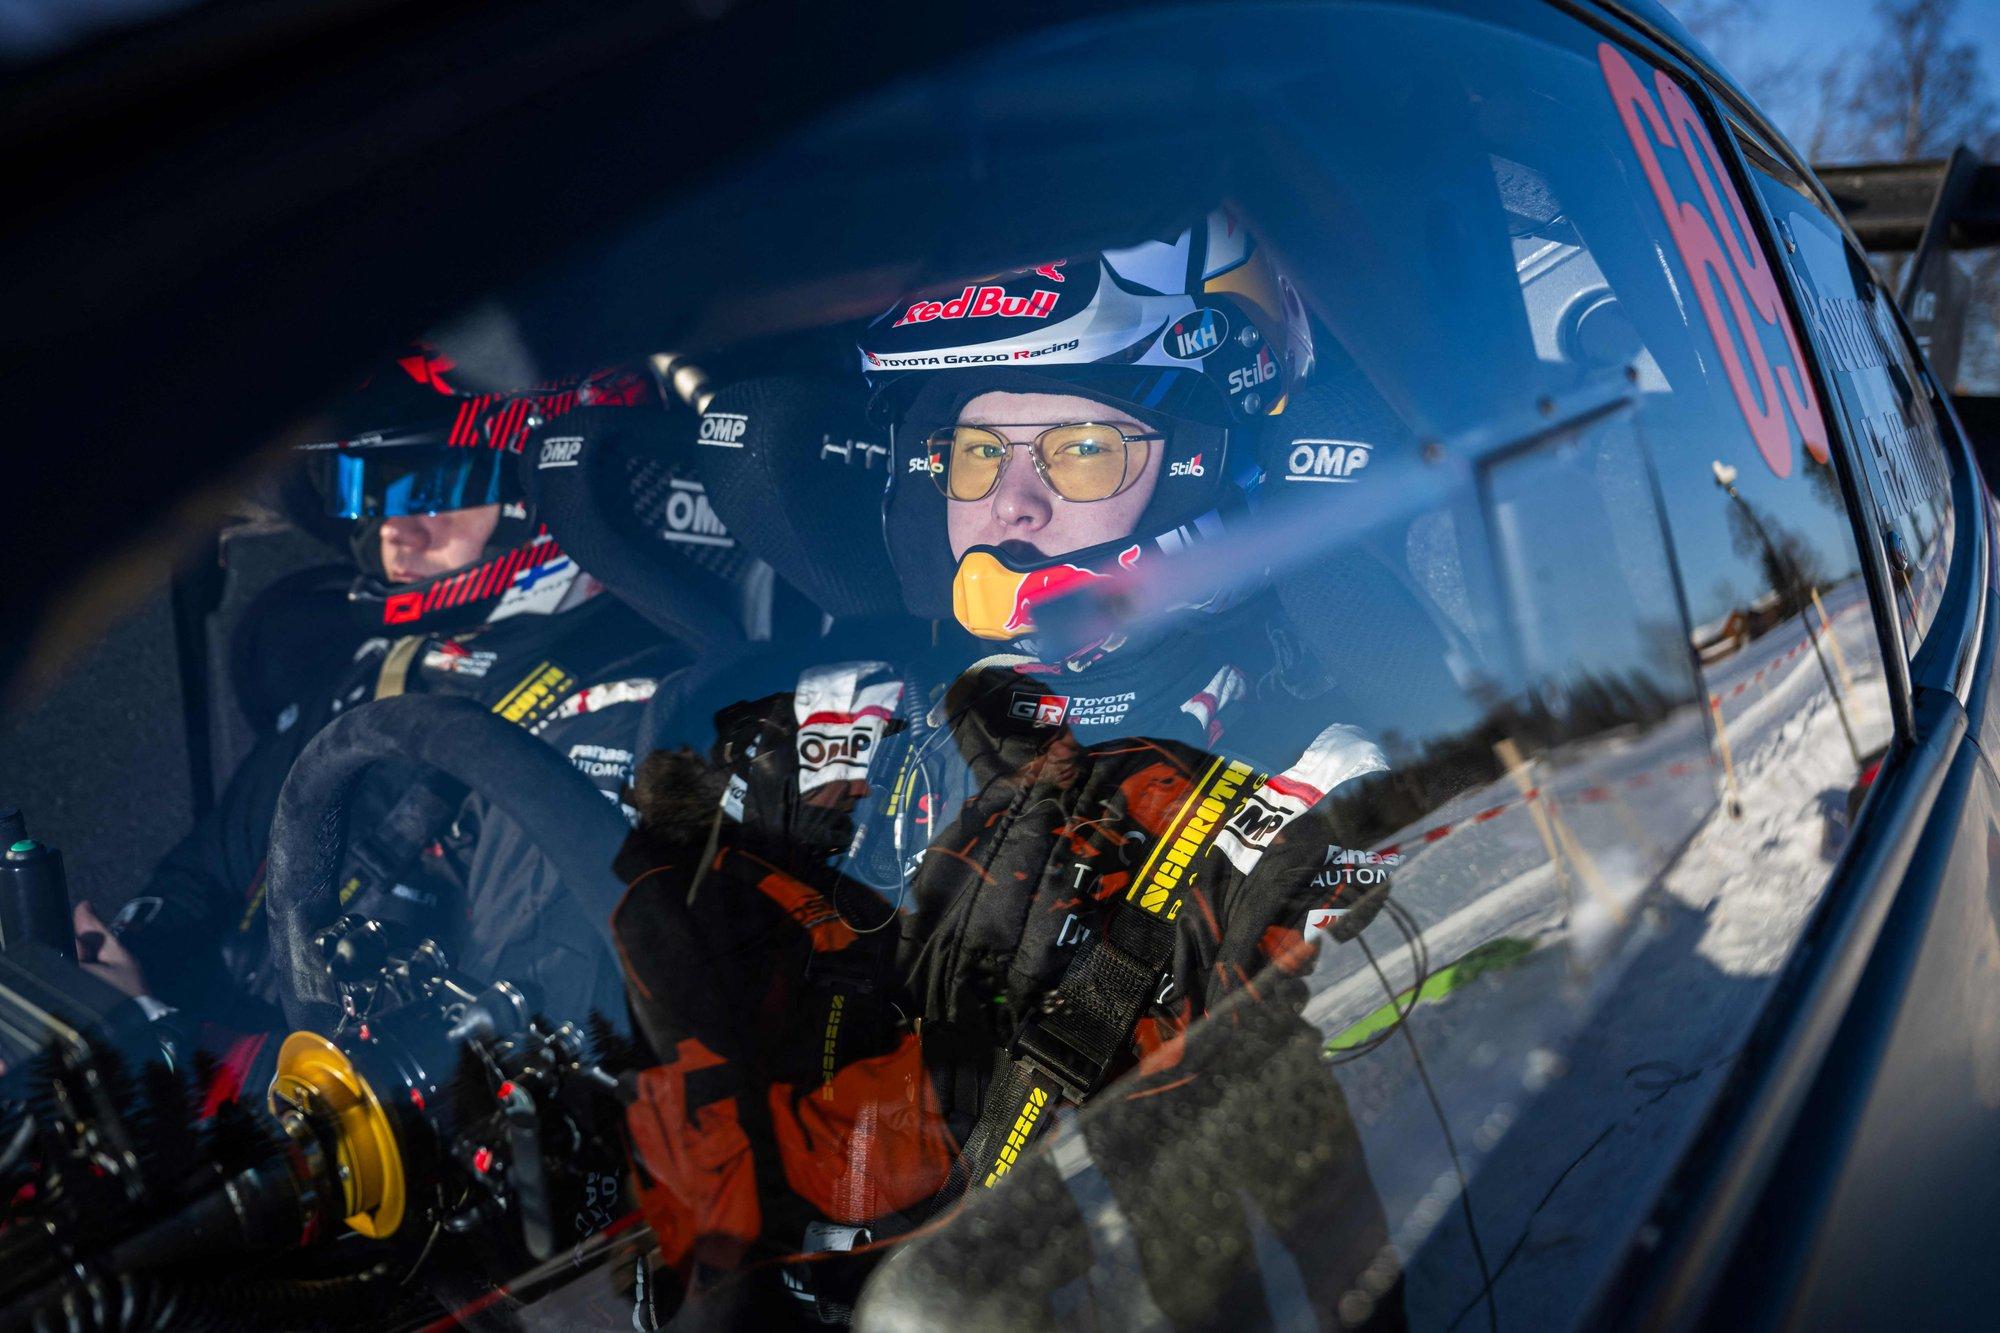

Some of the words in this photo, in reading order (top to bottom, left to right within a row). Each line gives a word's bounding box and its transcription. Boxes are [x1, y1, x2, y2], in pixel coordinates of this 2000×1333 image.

[1598, 42, 1828, 477] 69
[892, 286, 977, 328] Red
[969, 286, 1060, 319] Bull
[880, 356, 940, 367] TOYOTA
[944, 354, 1009, 364] GAZOO
[1014, 338, 1079, 360] Racing
[1228, 352, 1277, 395] Stilo
[701, 417, 746, 442] OMP
[540, 440, 583, 463] OMP
[820, 434, 892, 474] HT
[1288, 444, 1369, 476] OMP
[1169, 456, 1204, 477] Stilo
[1011, 701, 1063, 723] GR
[1069, 703, 1129, 716] GAZOO
[1073, 692, 1136, 707] TOYOTA
[1067, 714, 1125, 725] Racing
[1140, 759, 1254, 913] SCHROTH
[1234, 804, 1284, 842] MP
